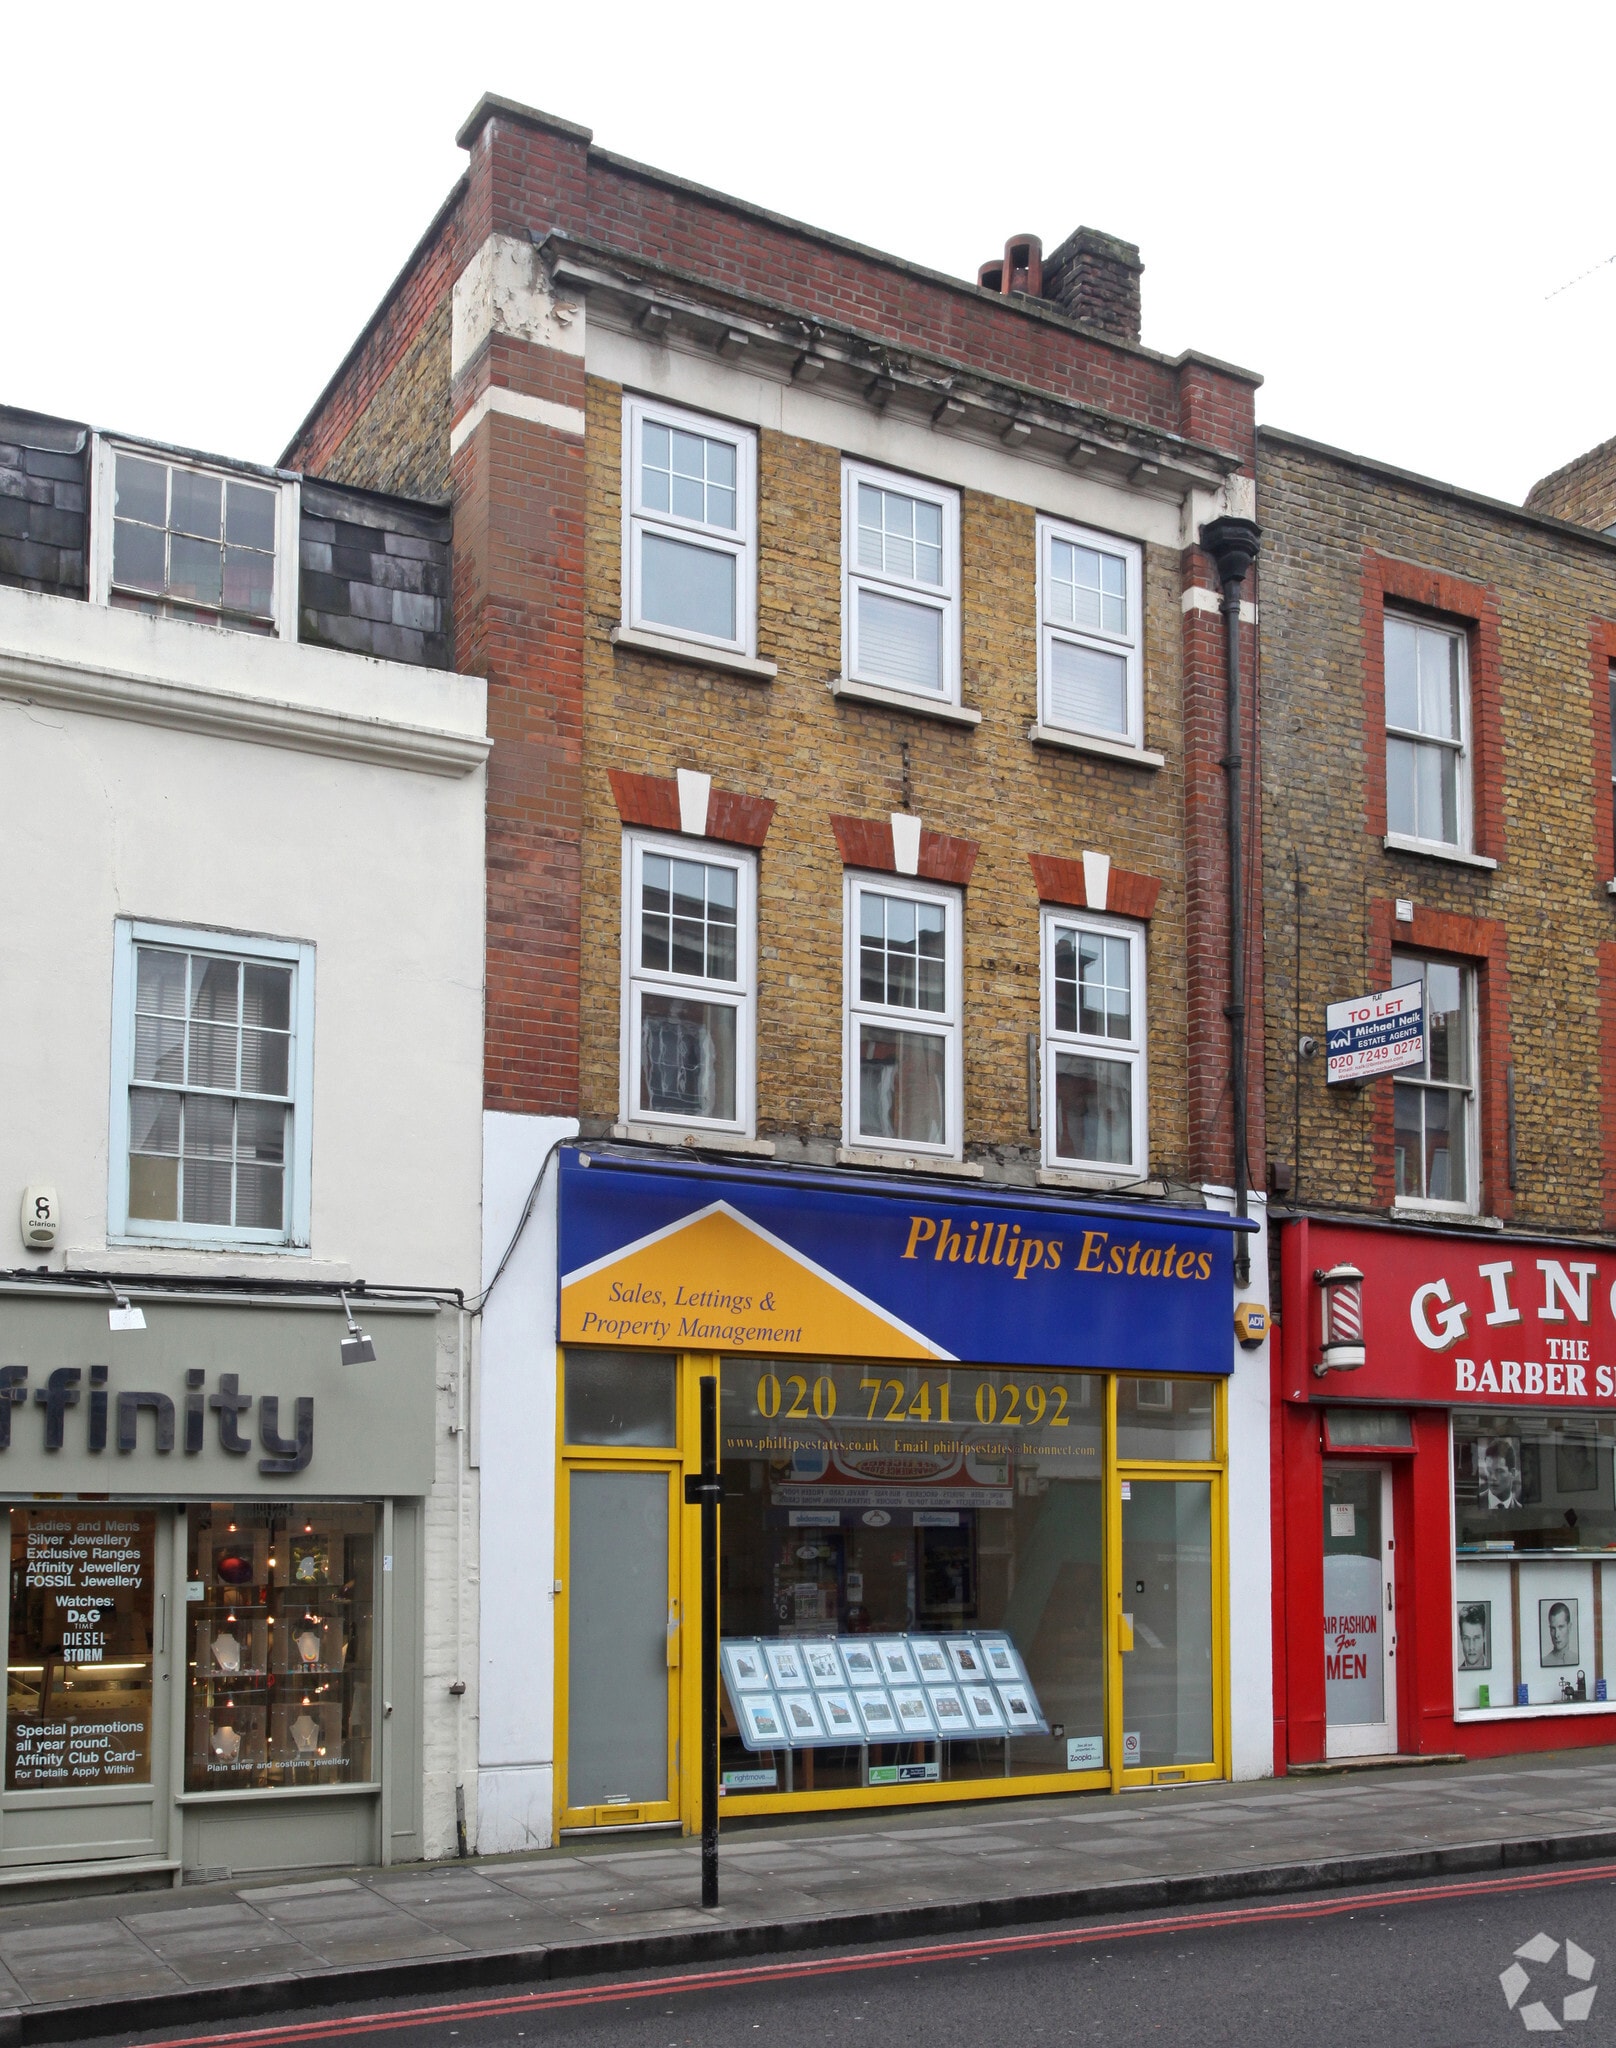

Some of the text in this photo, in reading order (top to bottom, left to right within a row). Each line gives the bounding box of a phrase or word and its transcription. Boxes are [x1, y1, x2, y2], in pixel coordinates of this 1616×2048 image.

[1348, 999, 1404, 1023] TO LET
[1355, 1012, 1420, 1037] Michael Naik
[1358, 1027, 1417, 1048] ESTATE AGENTS
[1330, 1038, 1422, 1070] 020 7249 0272
[28, 1220, 56, 1228] Clarion
[900, 1216, 1213, 1280] Phillips Estates
[608, 1281, 777, 1315] Sales, Lettings &
[1410, 1258, 1616, 1351] GIN
[580, 1311, 803, 1346] Property Management
[1249, 1316, 1264, 1327] ADT
[1546, 1338, 1590, 1361] THE
[1454, 1358, 1616, 1397] BARBER S
[756, 1373, 1070, 1427] 020 7241 0292
[727, 1436, 879, 1452] www.phillipsestates.co.uk
[894, 1438, 928, 1453] Email
[27, 1520, 140, 1532] Ladies and Mens
[27, 1533, 131, 1547] Silver Jewellery
[26, 1548, 141, 1561] Exclusive Ranges
[26, 1561, 141, 1575] Affinity Jewellery
[25, 1575, 142, 1589] FOSSIL Jewellery
[55, 1595, 115, 1607] Watches:
[67, 1610, 100, 1623] D&G
[1339, 1615, 1377, 1633] FASHION
[63, 1632, 106, 1646] DIESEL
[1334, 1633, 1357, 1654] For
[63, 1648, 103, 1662] STORM
[1326, 1654, 1367, 1680] MEN
[16, 1721, 144, 1739] Special promotions
[16, 1737, 111, 1753] all year round.
[15, 1752, 63, 1767] Affinity
[68, 1751, 100, 1764] Club
[207, 1757, 351, 1772] Plain silver and costume jewellery
[14, 1765, 134, 1779] For Details Apply Within
